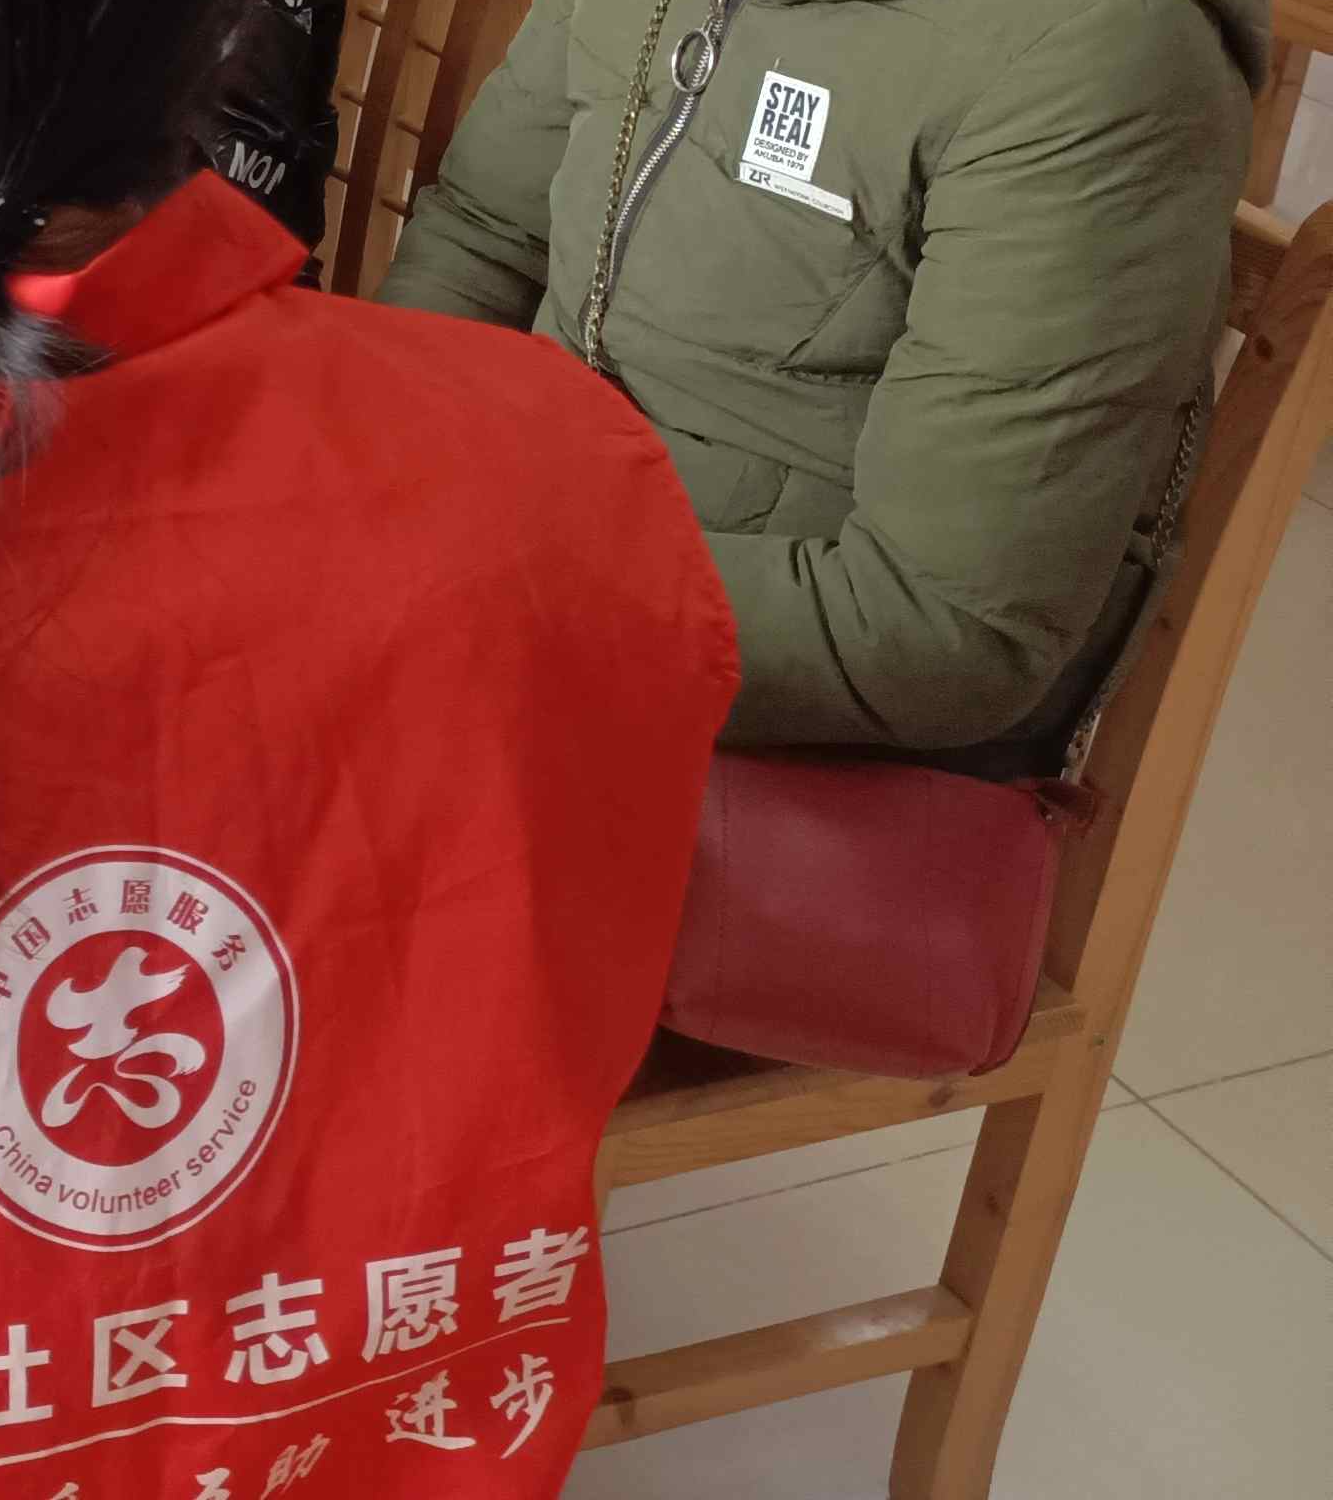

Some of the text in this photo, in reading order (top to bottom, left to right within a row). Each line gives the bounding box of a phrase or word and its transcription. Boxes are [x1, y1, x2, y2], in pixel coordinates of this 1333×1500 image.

[766, 82, 821, 121] STAY
[754, 137, 809, 162] DESIGNED BY
[759, 109, 812, 150] REAL
[58, 1170, 184, 1214] volunteer
[186, 1078, 257, 1177] service
[384, 1352, 557, 1458] 进步
